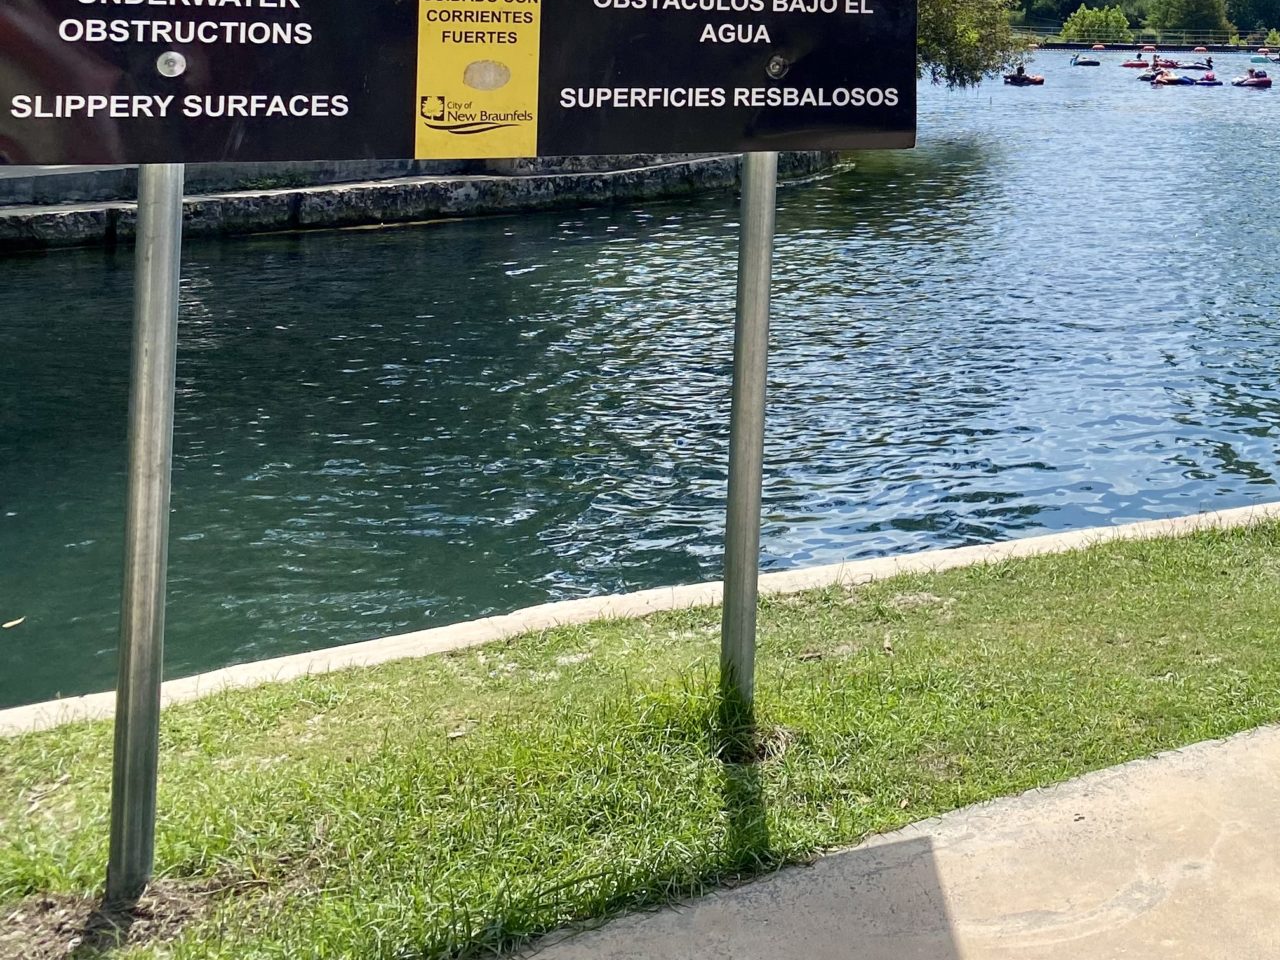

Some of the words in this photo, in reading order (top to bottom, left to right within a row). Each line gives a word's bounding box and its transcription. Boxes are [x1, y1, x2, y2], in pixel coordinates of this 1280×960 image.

[427, 10, 533, 23] CORRIENTES
[59, 19, 312, 44] OBSTRUCTIONS
[442, 31, 517, 43] FUERTES
[700, 24, 770, 43] AGUA
[447, 101, 462, 110] City
[464, 101, 472, 109] of
[560, 88, 725, 107] SUPERFICIES
[734, 88, 898, 106] RESBALOSOS
[11, 95, 174, 117] SLIPPERY
[183, 95, 348, 117] SURFACES
[448, 111, 476, 121] New
[480, 110, 533, 121] Braunfels
